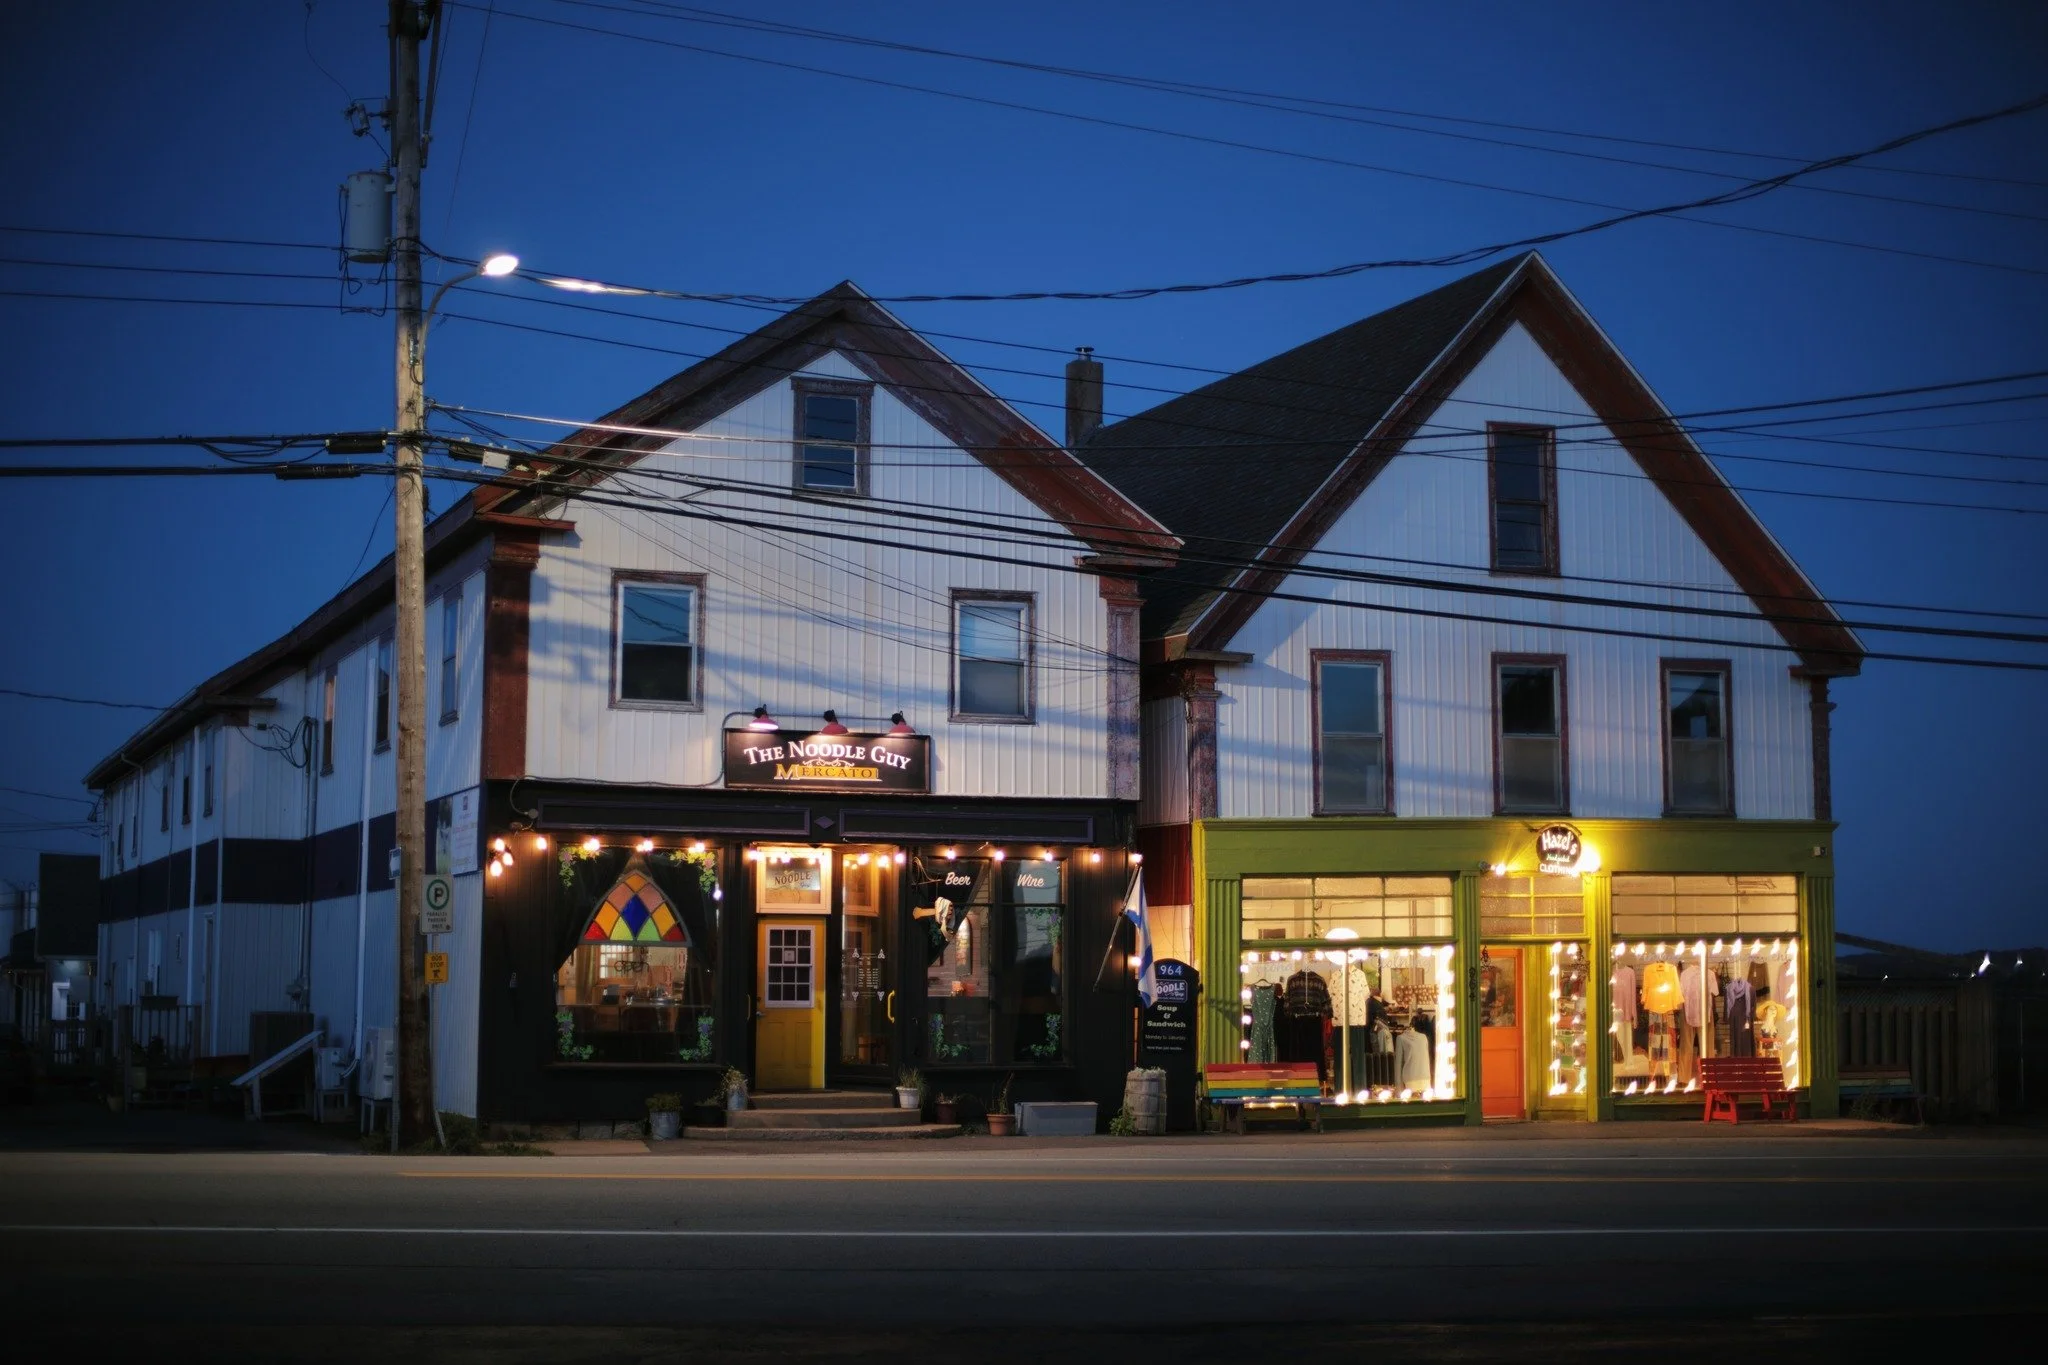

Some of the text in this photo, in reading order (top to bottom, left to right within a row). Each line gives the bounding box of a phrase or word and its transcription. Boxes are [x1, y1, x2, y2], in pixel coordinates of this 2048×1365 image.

[744, 740, 912, 769] THE NOODLE GUY
[774, 763, 878, 781] MERCATO
[1542, 830, 1578, 855] Hazel's
[774, 872, 812, 886] NOODLE
[945, 871, 971, 886] Beer
[1017, 874, 1045, 887] Wine
[1160, 965, 1182, 975] 964
[1157, 983, 1185, 994] OODLE
[1157, 1004, 1178, 1013] Soup
